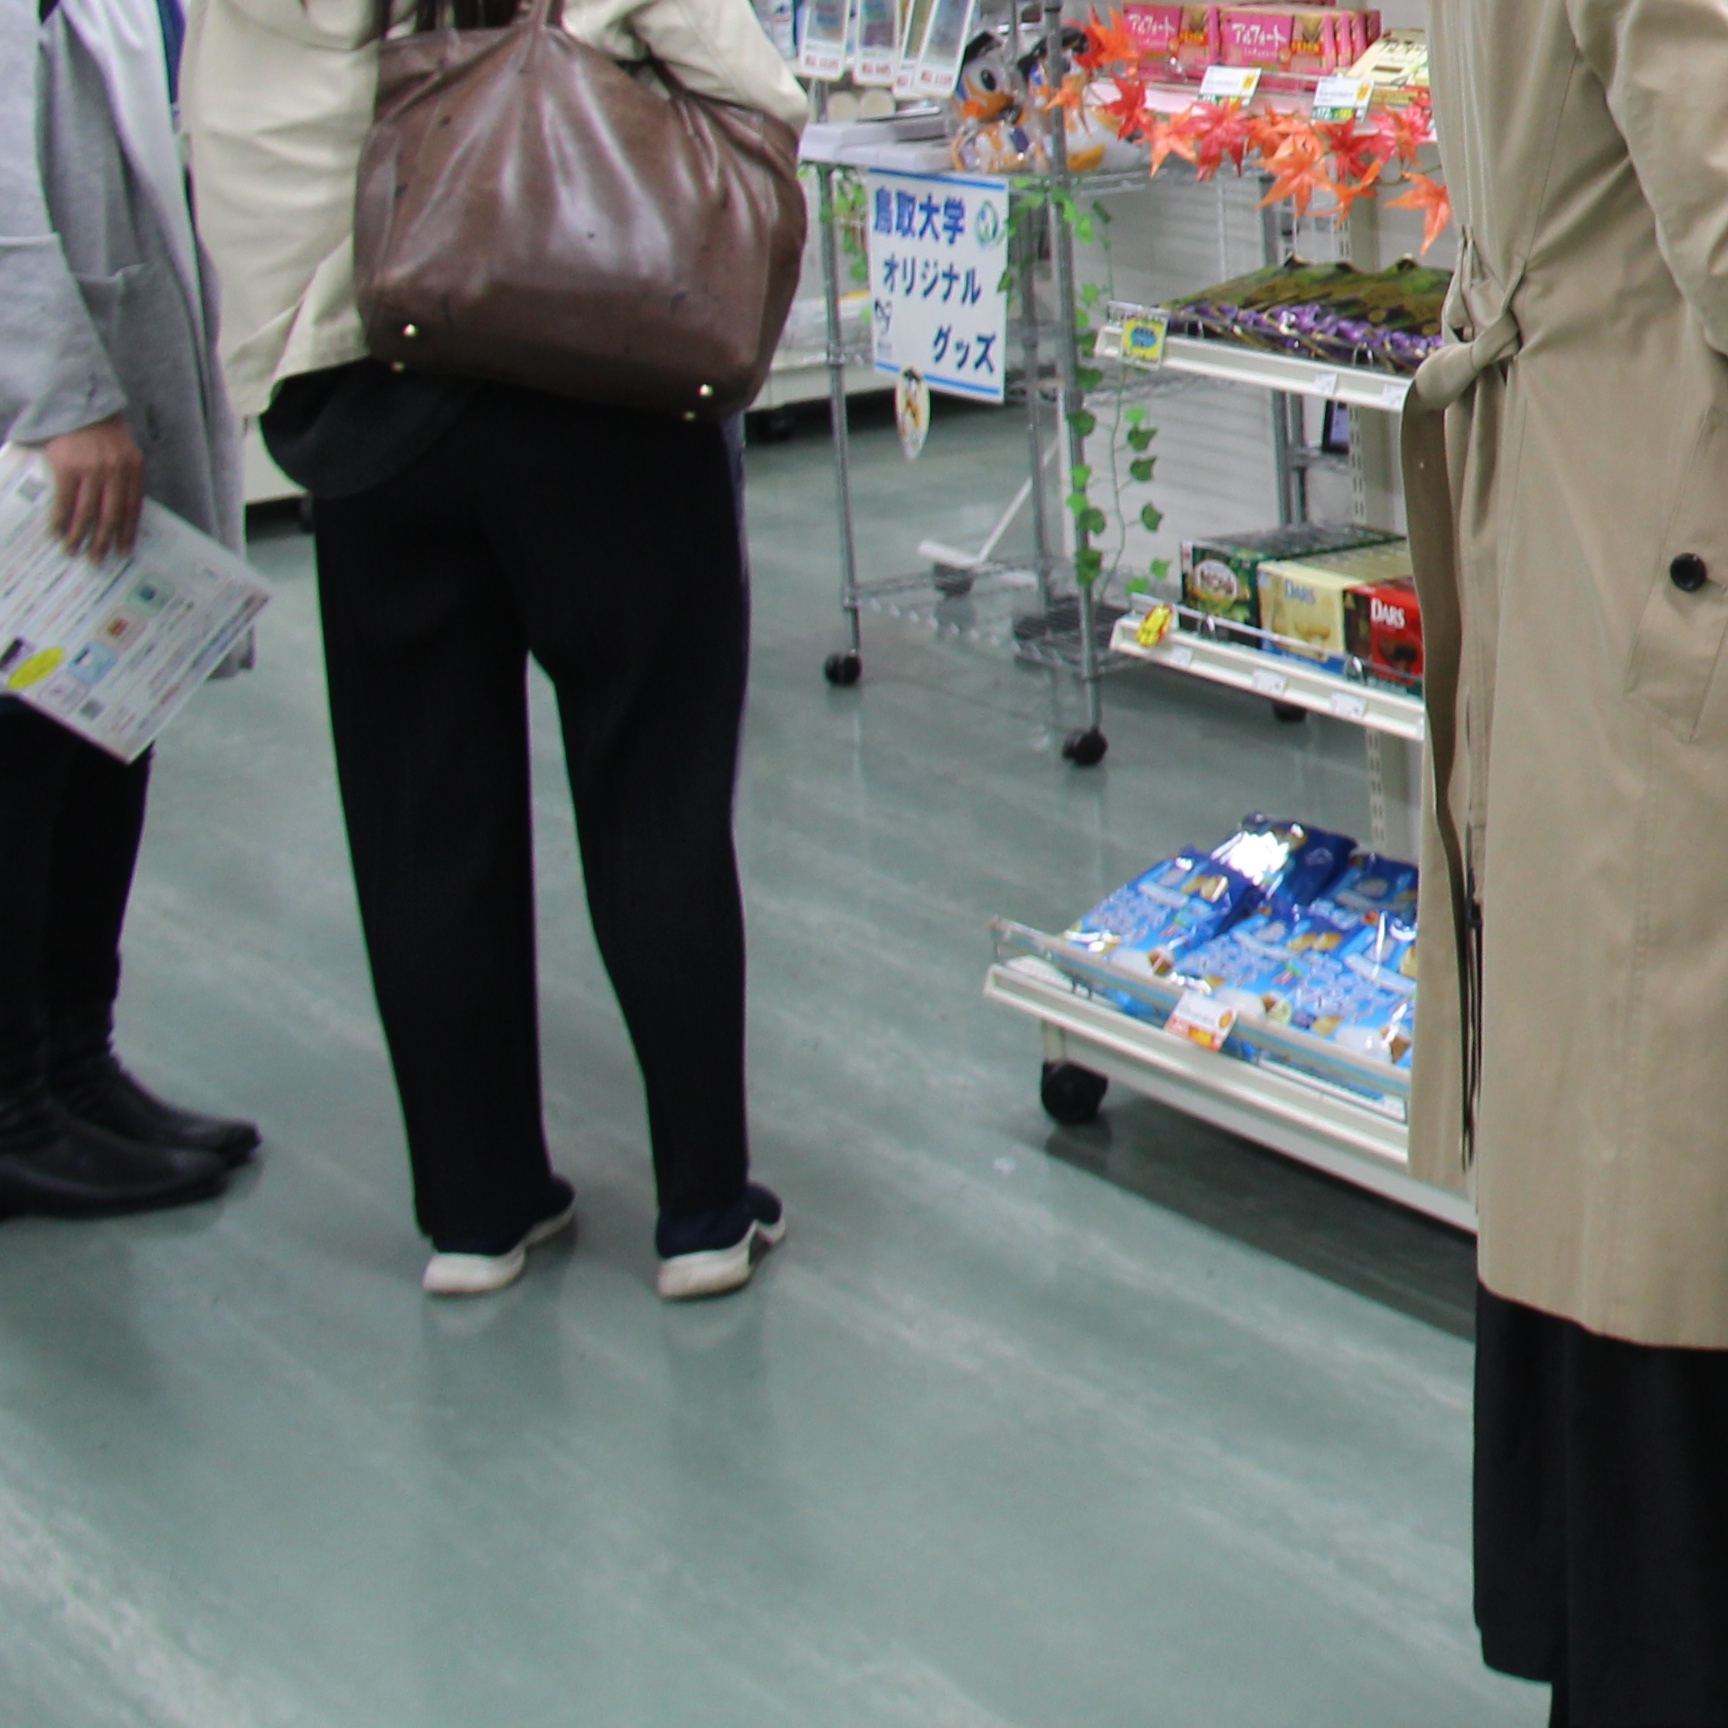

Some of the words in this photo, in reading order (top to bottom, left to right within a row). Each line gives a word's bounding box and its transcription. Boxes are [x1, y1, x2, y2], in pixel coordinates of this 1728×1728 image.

[874, 185, 965, 245] 鳥取大学
[884, 251, 981, 306] オリジナル
[933, 324, 997, 373] グッズ
[1371, 597, 1406, 629] DARS
